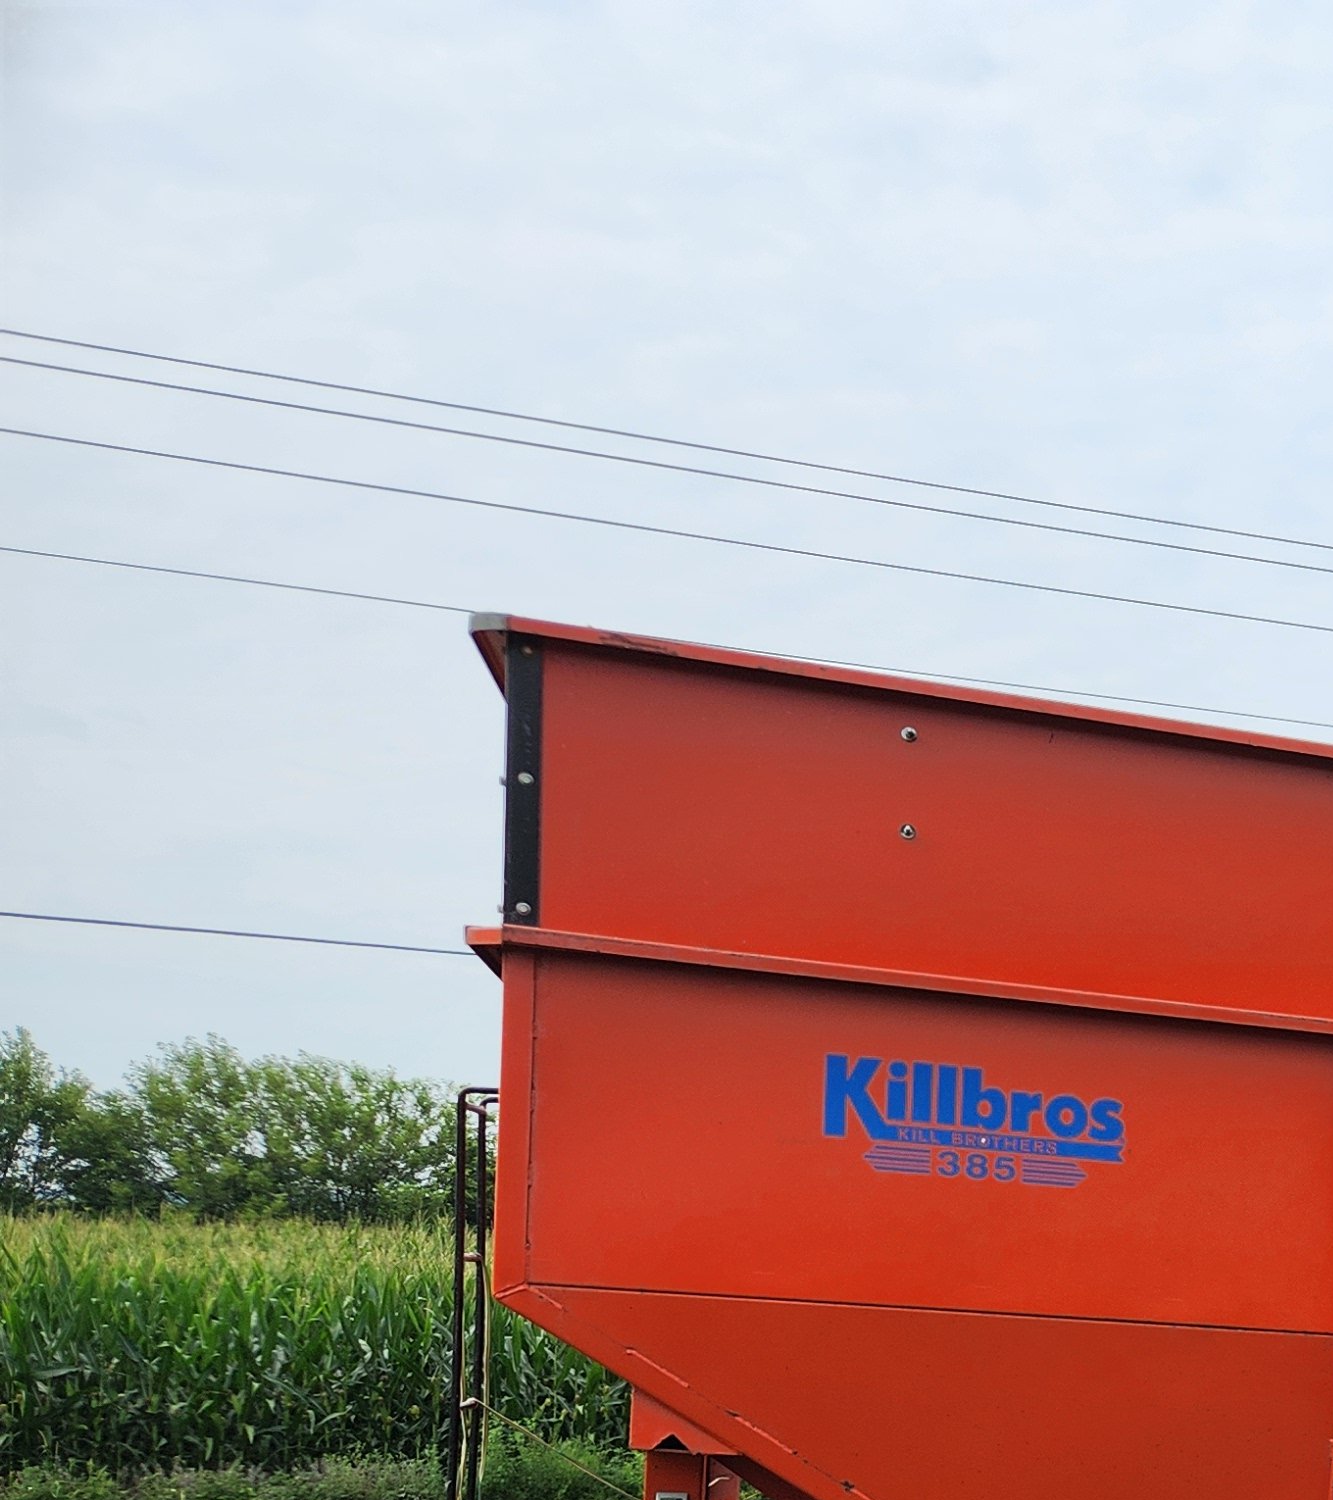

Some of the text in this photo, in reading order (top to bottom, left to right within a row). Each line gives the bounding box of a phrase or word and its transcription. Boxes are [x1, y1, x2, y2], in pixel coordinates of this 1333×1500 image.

[822, 1052, 1126, 1145] Killbros
[898, 1127, 1058, 1155] KILL BROTHERS
[936, 1150, 1017, 1181] 385
